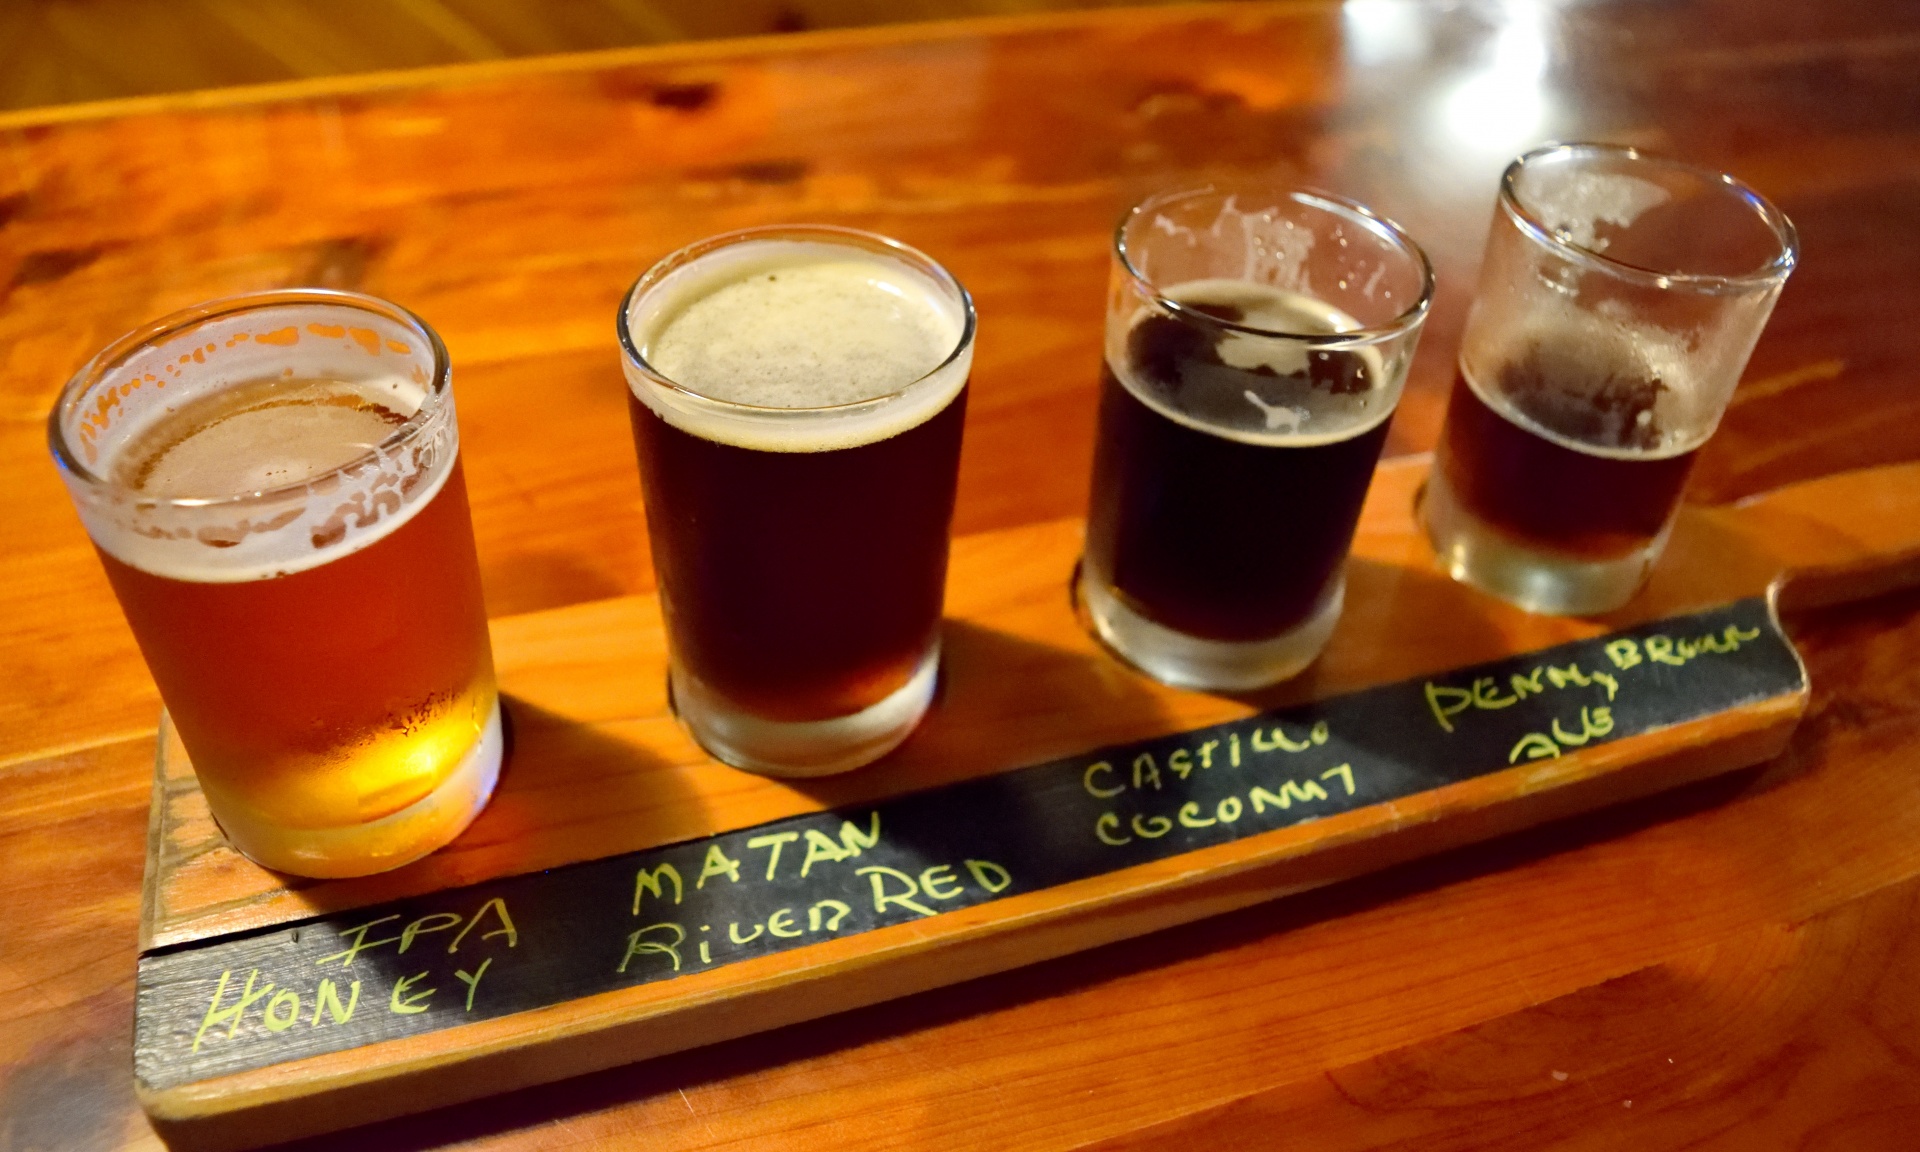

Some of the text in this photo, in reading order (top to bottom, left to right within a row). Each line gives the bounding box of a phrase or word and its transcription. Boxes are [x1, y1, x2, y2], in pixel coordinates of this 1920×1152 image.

[1096, 763, 1356, 845] COCONUT
[632, 811, 880, 916] MATAN
[856, 859, 1012, 916] RED
[316, 897, 518, 967] IPA
[192, 957, 493, 1054] HONEY
